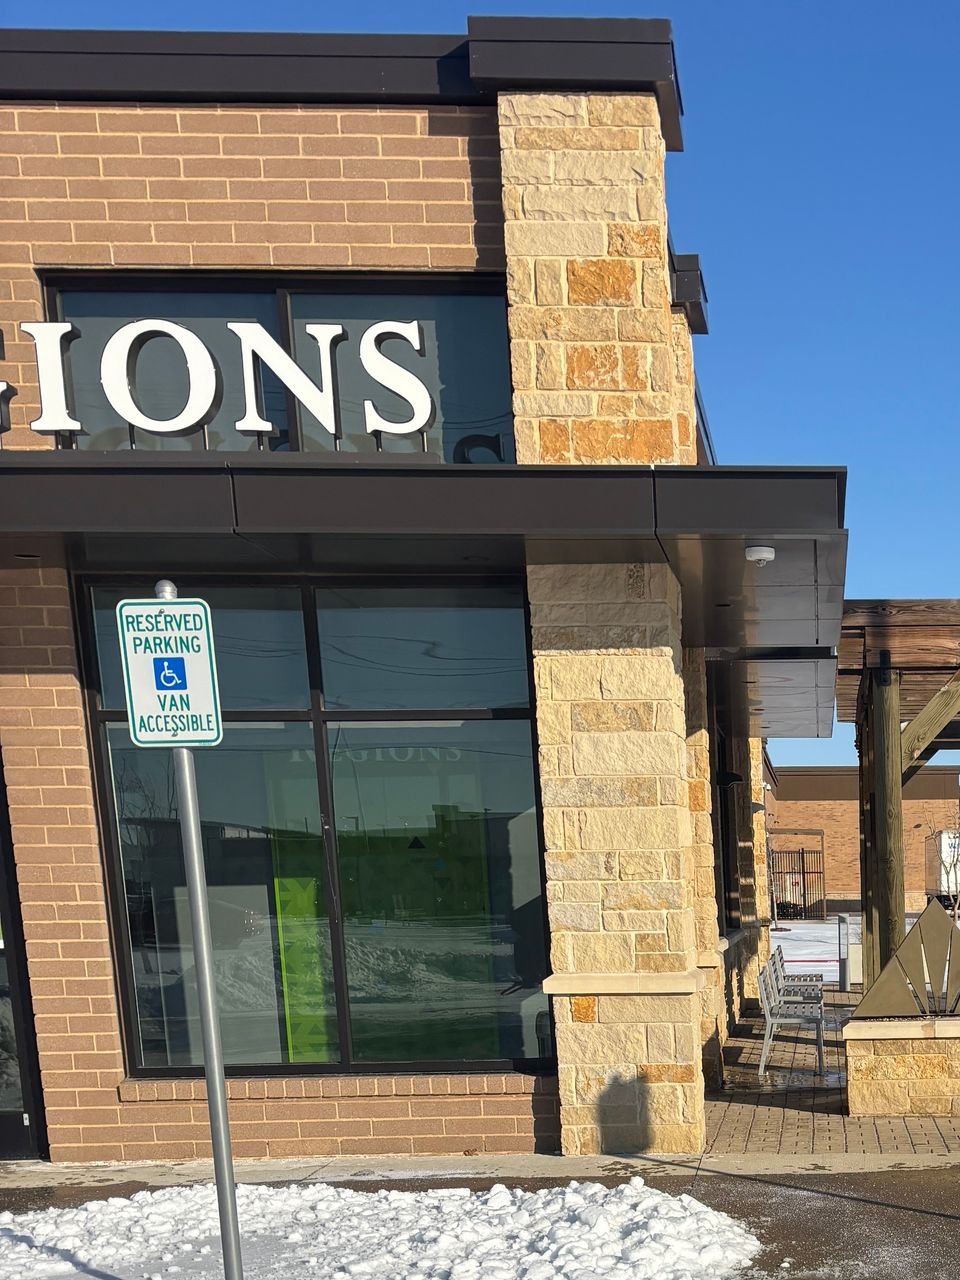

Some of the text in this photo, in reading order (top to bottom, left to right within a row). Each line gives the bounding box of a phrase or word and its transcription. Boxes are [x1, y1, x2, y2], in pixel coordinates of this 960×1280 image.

[0, 318, 434, 435] IONS
[125, 613, 203, 633] RESERVED
[133, 636, 201, 654] PARKING
[157, 694, 190, 712] VAN
[138, 714, 215, 733] ACCESSIBLE
